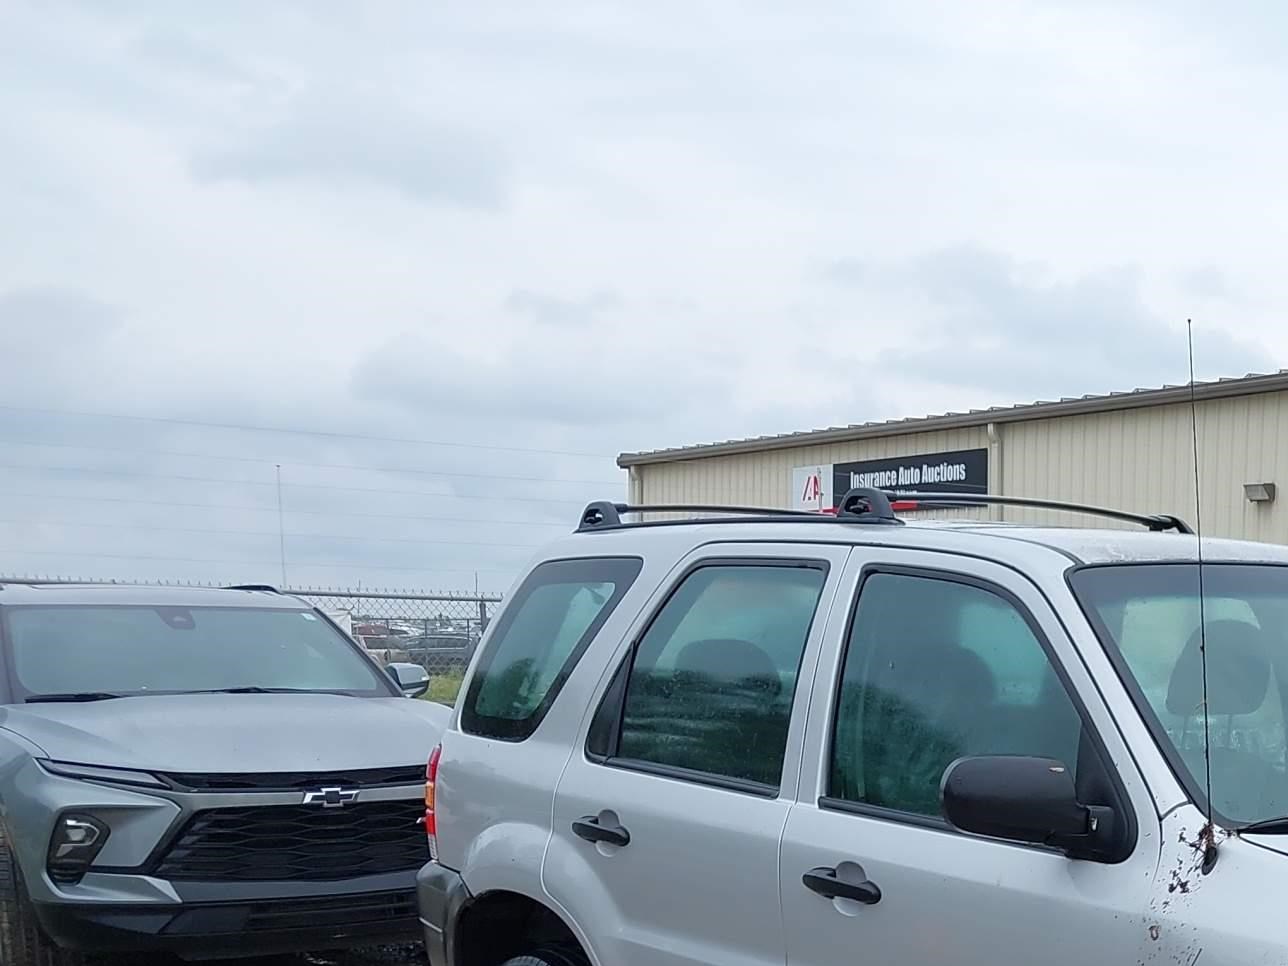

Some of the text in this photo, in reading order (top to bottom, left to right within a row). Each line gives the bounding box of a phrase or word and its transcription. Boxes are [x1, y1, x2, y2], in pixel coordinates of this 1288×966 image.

[850, 462, 966, 488] Insurance Auto Auctions
